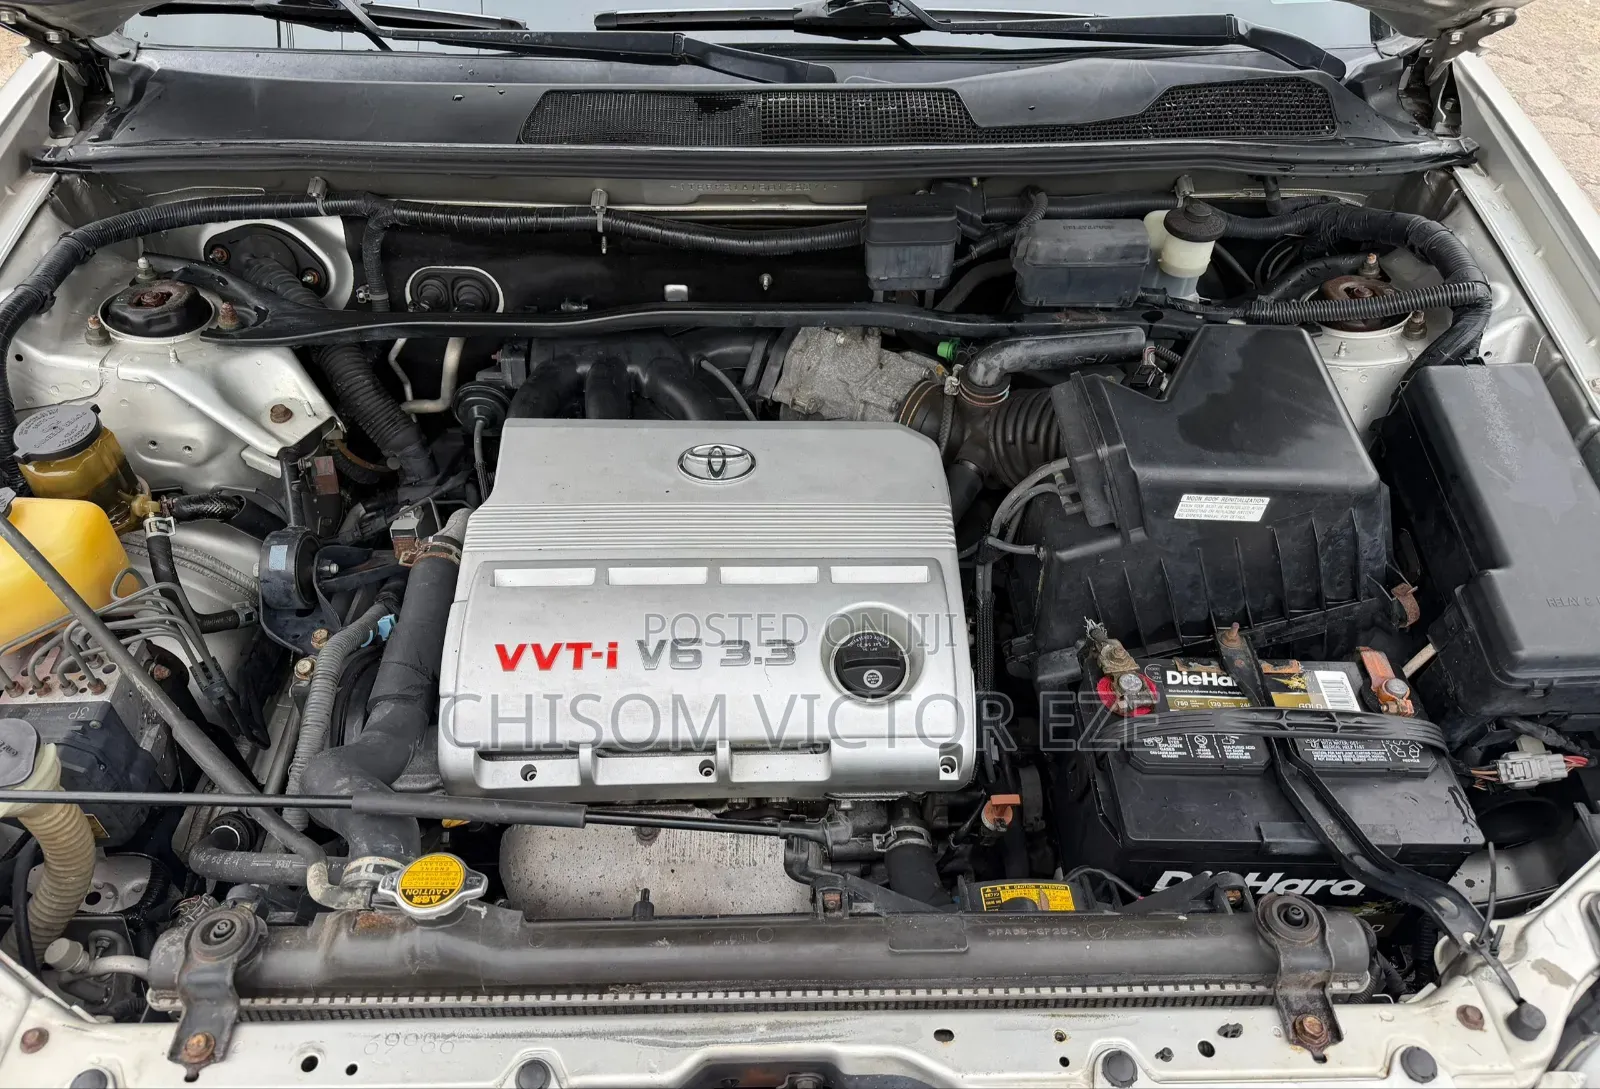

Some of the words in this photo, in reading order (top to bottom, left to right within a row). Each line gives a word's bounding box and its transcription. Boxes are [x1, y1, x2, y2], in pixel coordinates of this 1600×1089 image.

[1546, 596, 1581, 607] RELAY
[494, 641, 620, 673] VVT-i
[635, 638, 704, 671] V6
[720, 638, 797, 667] 3.3
[1152, 870, 1367, 897] DHard
